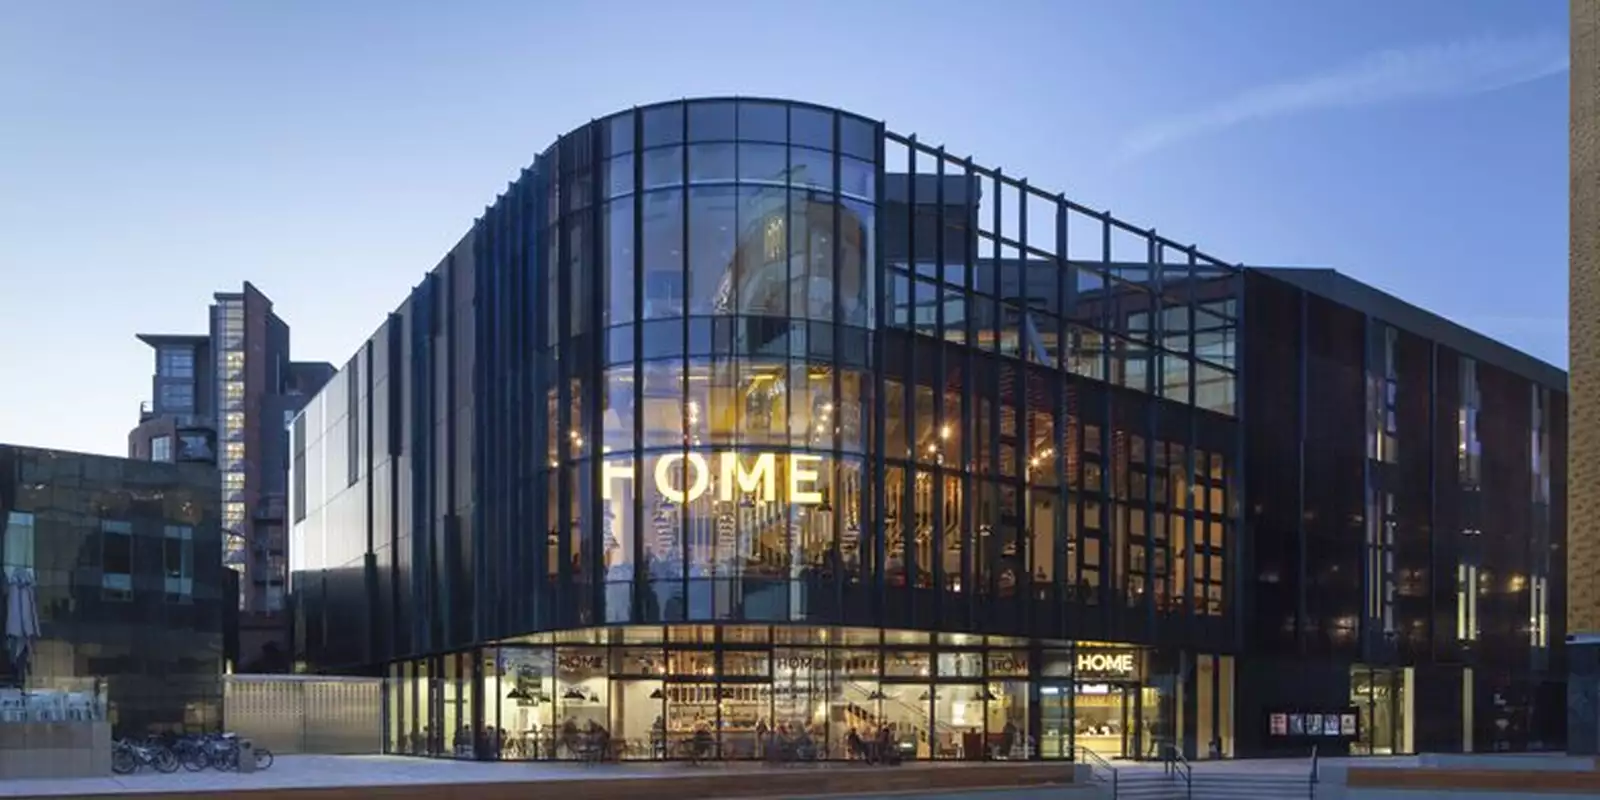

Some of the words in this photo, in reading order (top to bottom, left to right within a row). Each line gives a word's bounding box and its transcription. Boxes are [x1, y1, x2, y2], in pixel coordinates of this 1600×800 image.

[602, 447, 823, 504] HOME
[991, 659, 1026, 671] HOM
[1077, 653, 1134, 671] HOME
